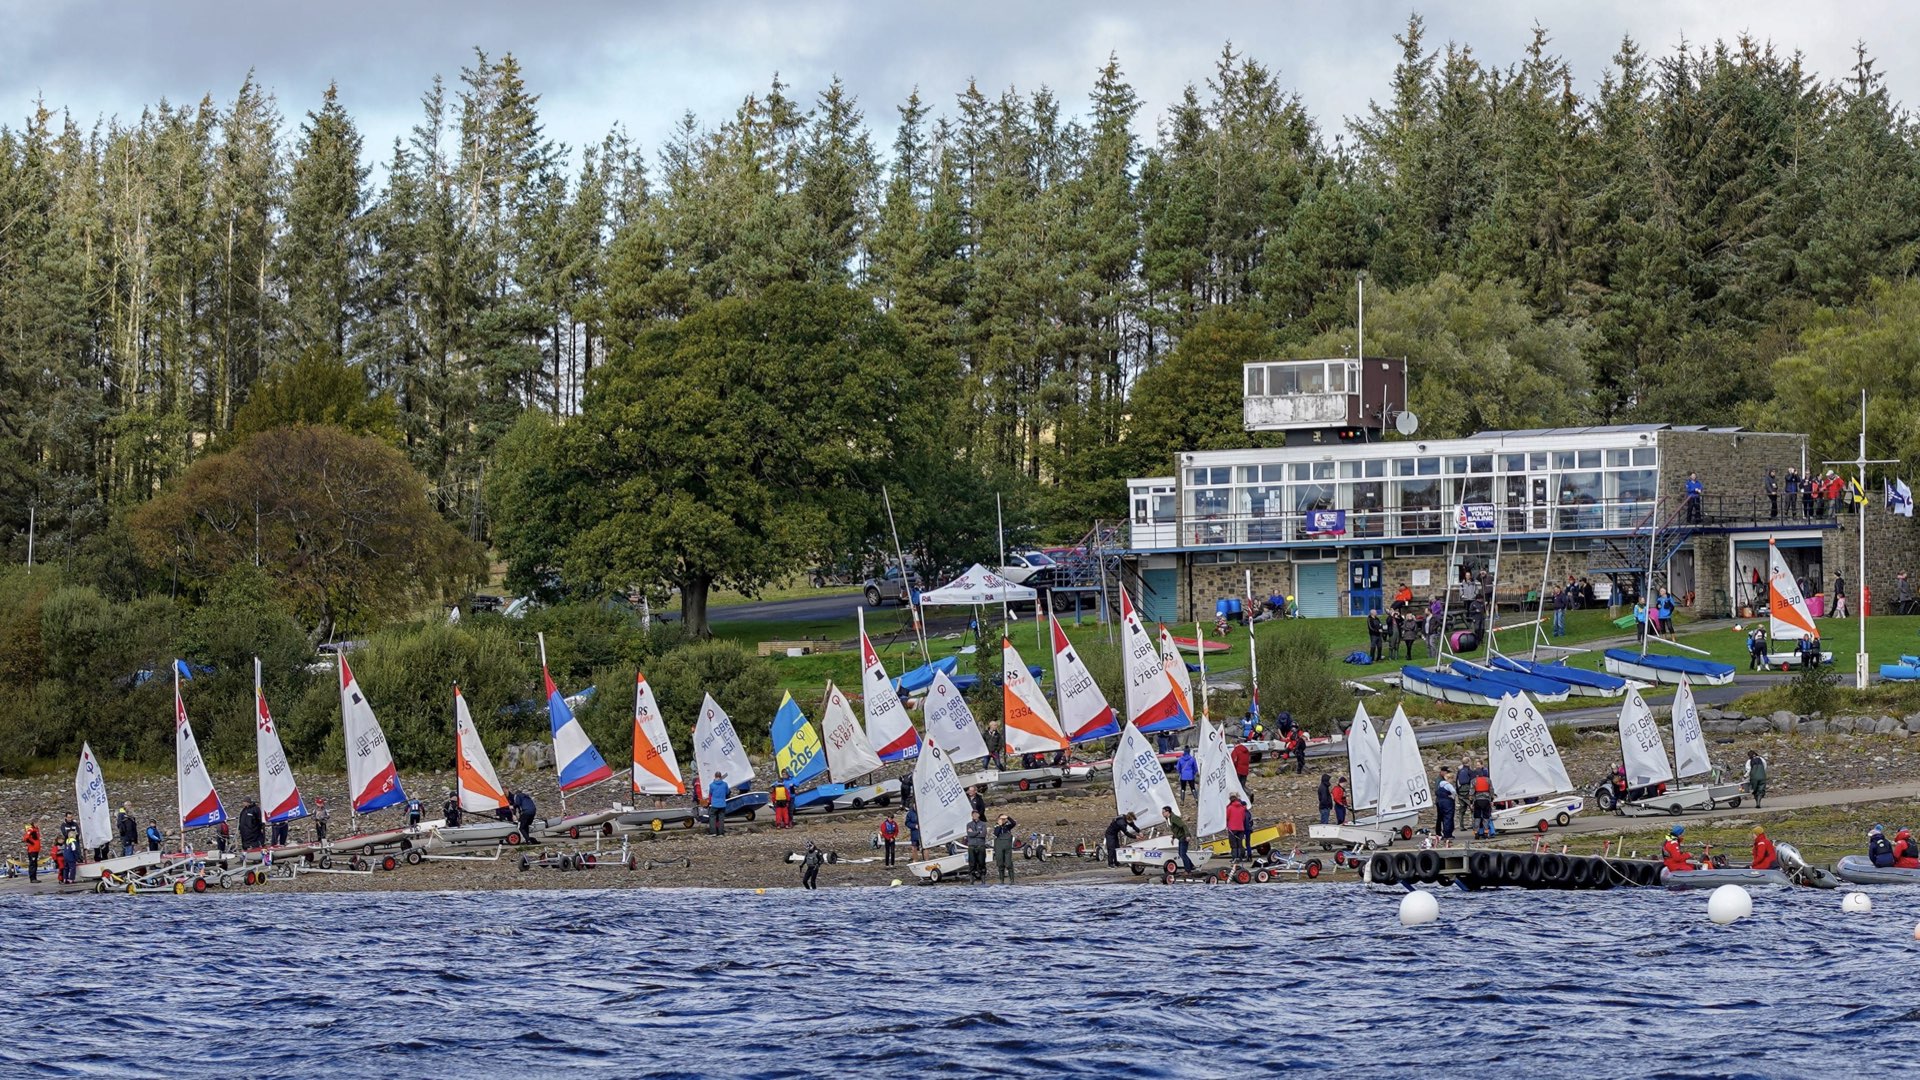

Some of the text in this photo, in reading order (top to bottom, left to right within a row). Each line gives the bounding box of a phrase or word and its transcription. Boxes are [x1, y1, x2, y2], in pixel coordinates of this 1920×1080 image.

[1133, 642, 1153, 660] GBR
[1133, 661, 1164, 688] 47860
[1066, 676, 1093, 699] 44200
[637, 705, 649, 716] RS
[870, 695, 899, 718] 43834
[946, 695, 963, 711] GBR
[713, 717, 730, 737] GBR
[954, 713, 973, 730] 6013
[1509, 721, 1532, 740] GBR
[1133, 750, 1155, 770] GBR
[1514, 742, 1541, 763] 5760
[934, 763, 953, 782] GBR
[1137, 770, 1165, 793] 5782
[940, 783, 963, 808] 5296
[1409, 788, 1429, 808] 130
